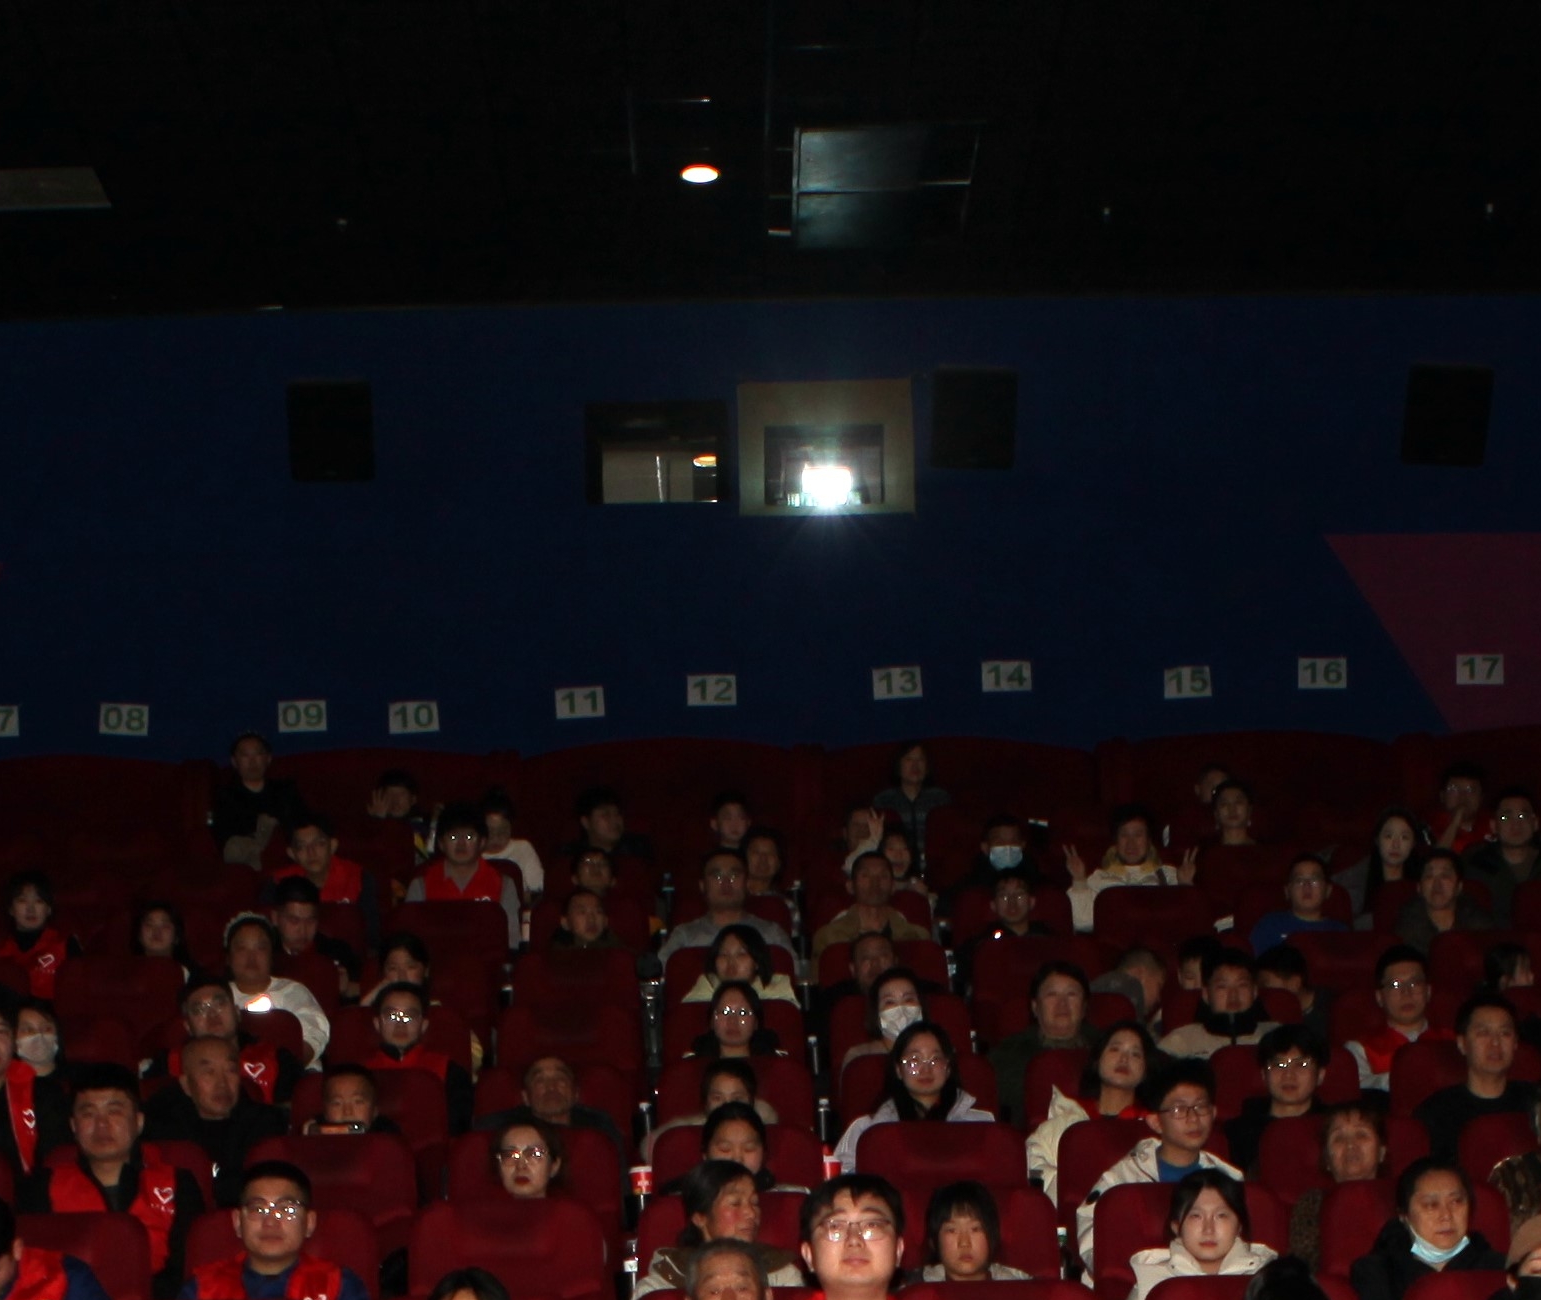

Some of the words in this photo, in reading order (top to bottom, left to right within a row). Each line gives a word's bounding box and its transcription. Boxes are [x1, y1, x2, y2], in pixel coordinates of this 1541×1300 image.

[986, 664, 1027, 687] 14
[1303, 661, 1343, 685] 16
[1462, 658, 1500, 680] 17
[693, 678, 733, 702] 12
[878, 670, 918, 694] 13
[1169, 669, 1209, 694] 15
[561, 690, 599, 714] 11
[104, 706, 146, 731] 08
[282, 703, 324, 728] 09
[394, 705, 434, 729] 10
